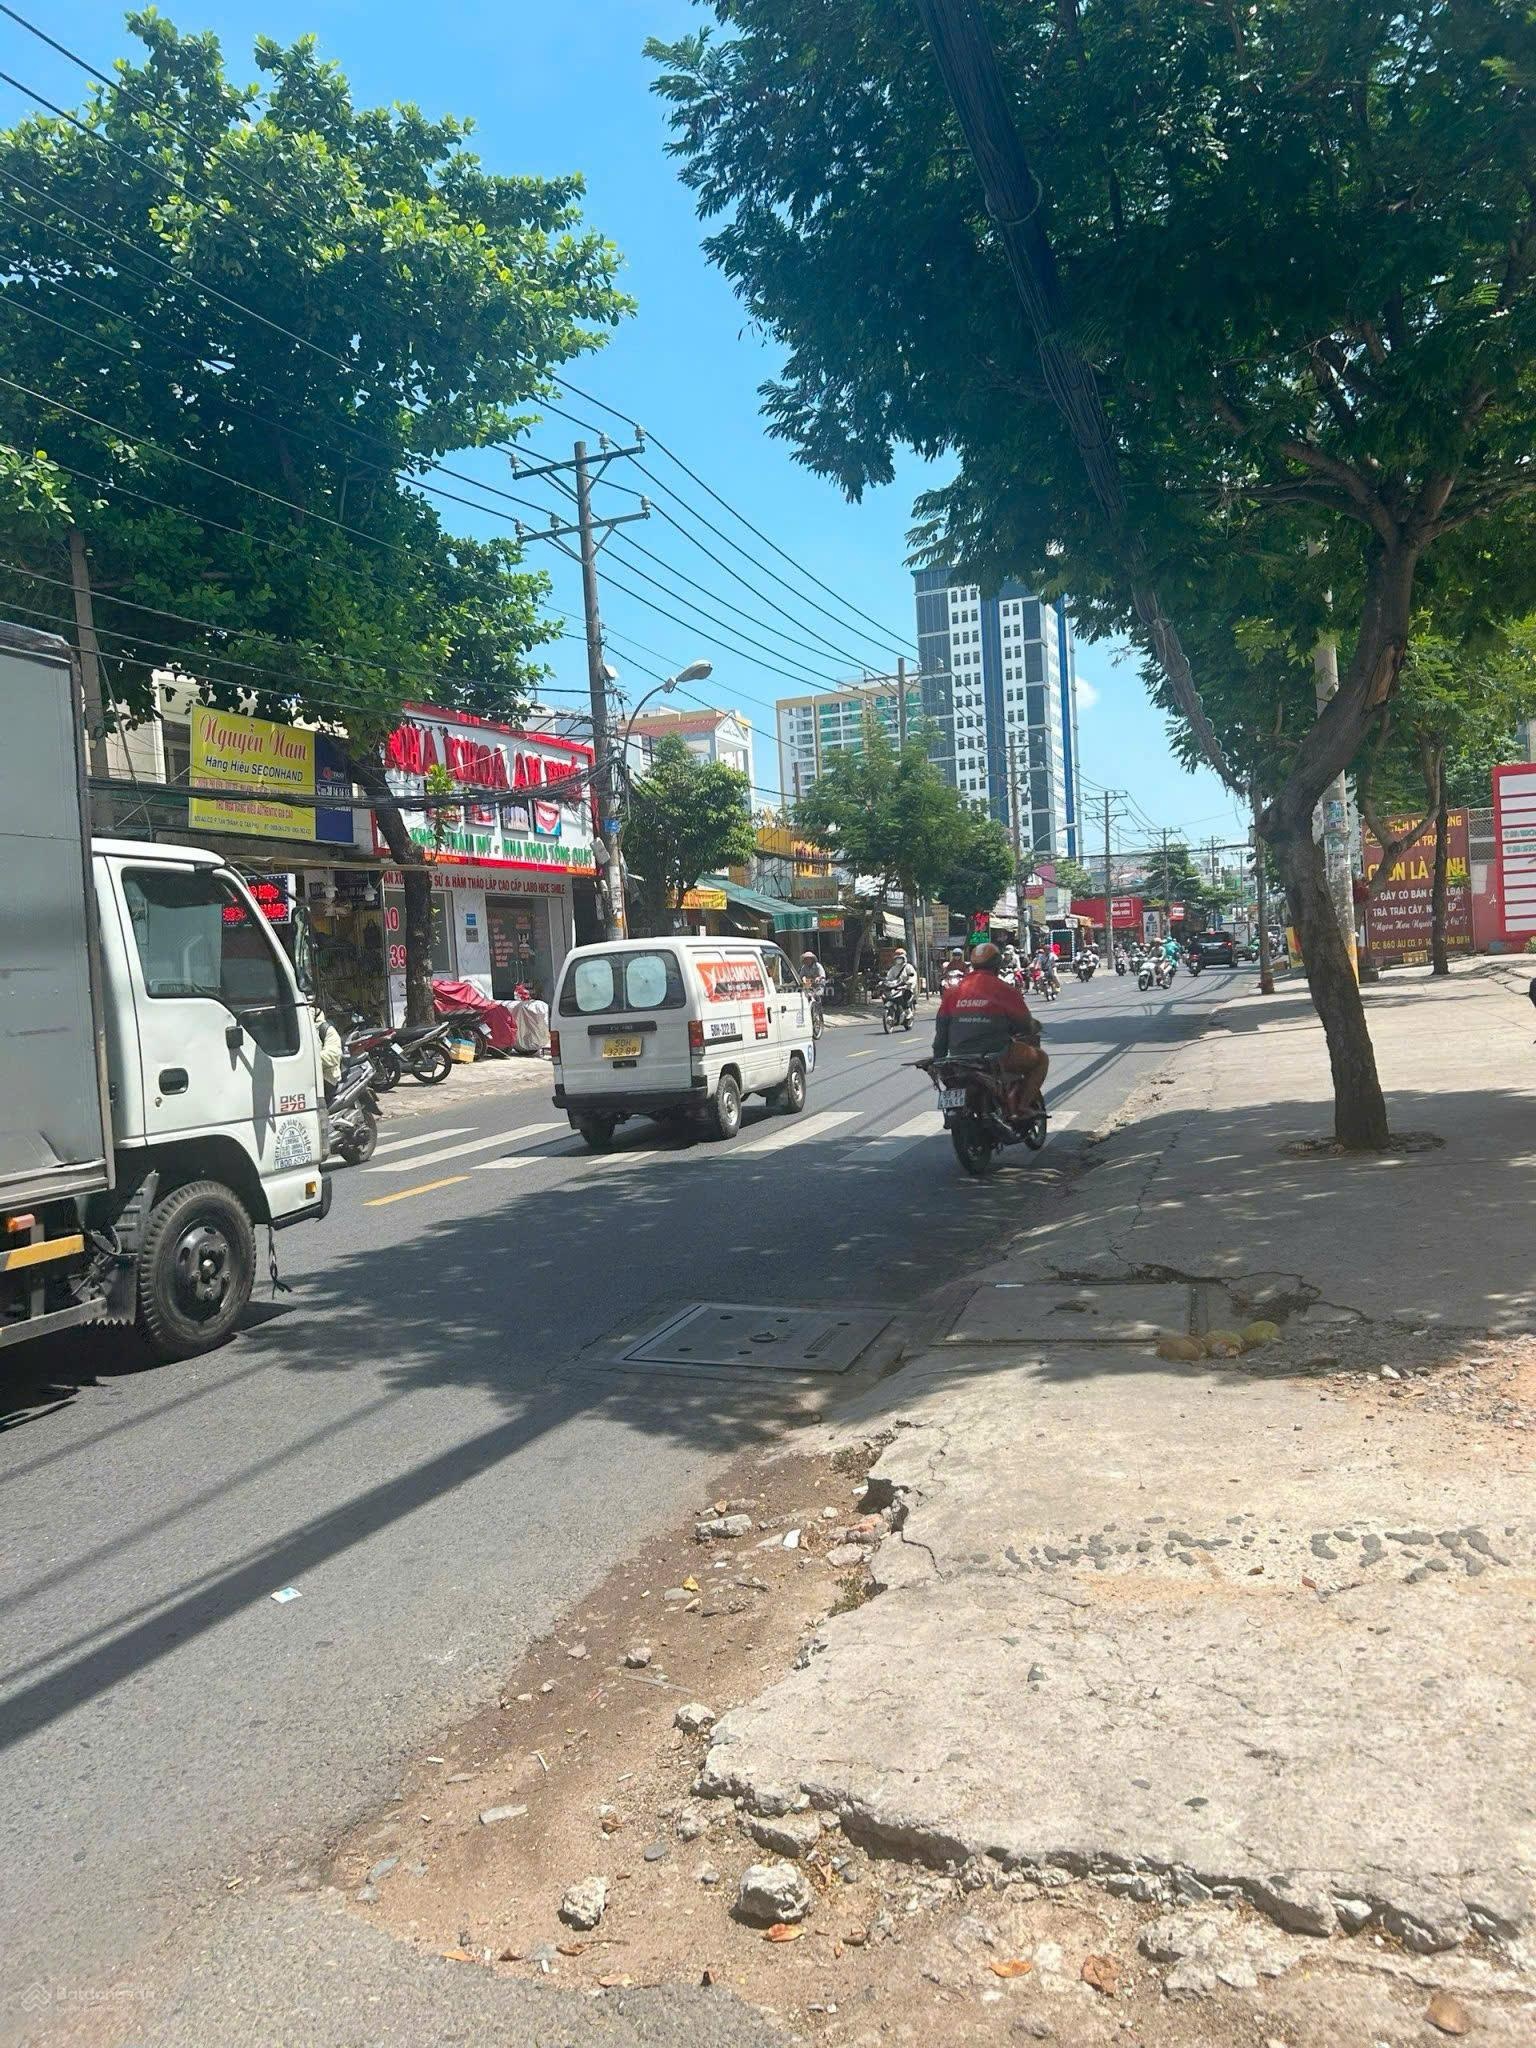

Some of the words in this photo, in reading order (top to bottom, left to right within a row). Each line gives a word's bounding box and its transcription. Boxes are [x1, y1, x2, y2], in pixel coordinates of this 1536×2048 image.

[270, 729, 307, 761] Nam
[205, 756, 228, 773] Hàng
[230, 760, 250, 774] Hiệu
[251, 763, 304, 782] SECONHAND
[1411, 856, 1429, 879] LÀ
[281, 1102, 306, 1112] 270
